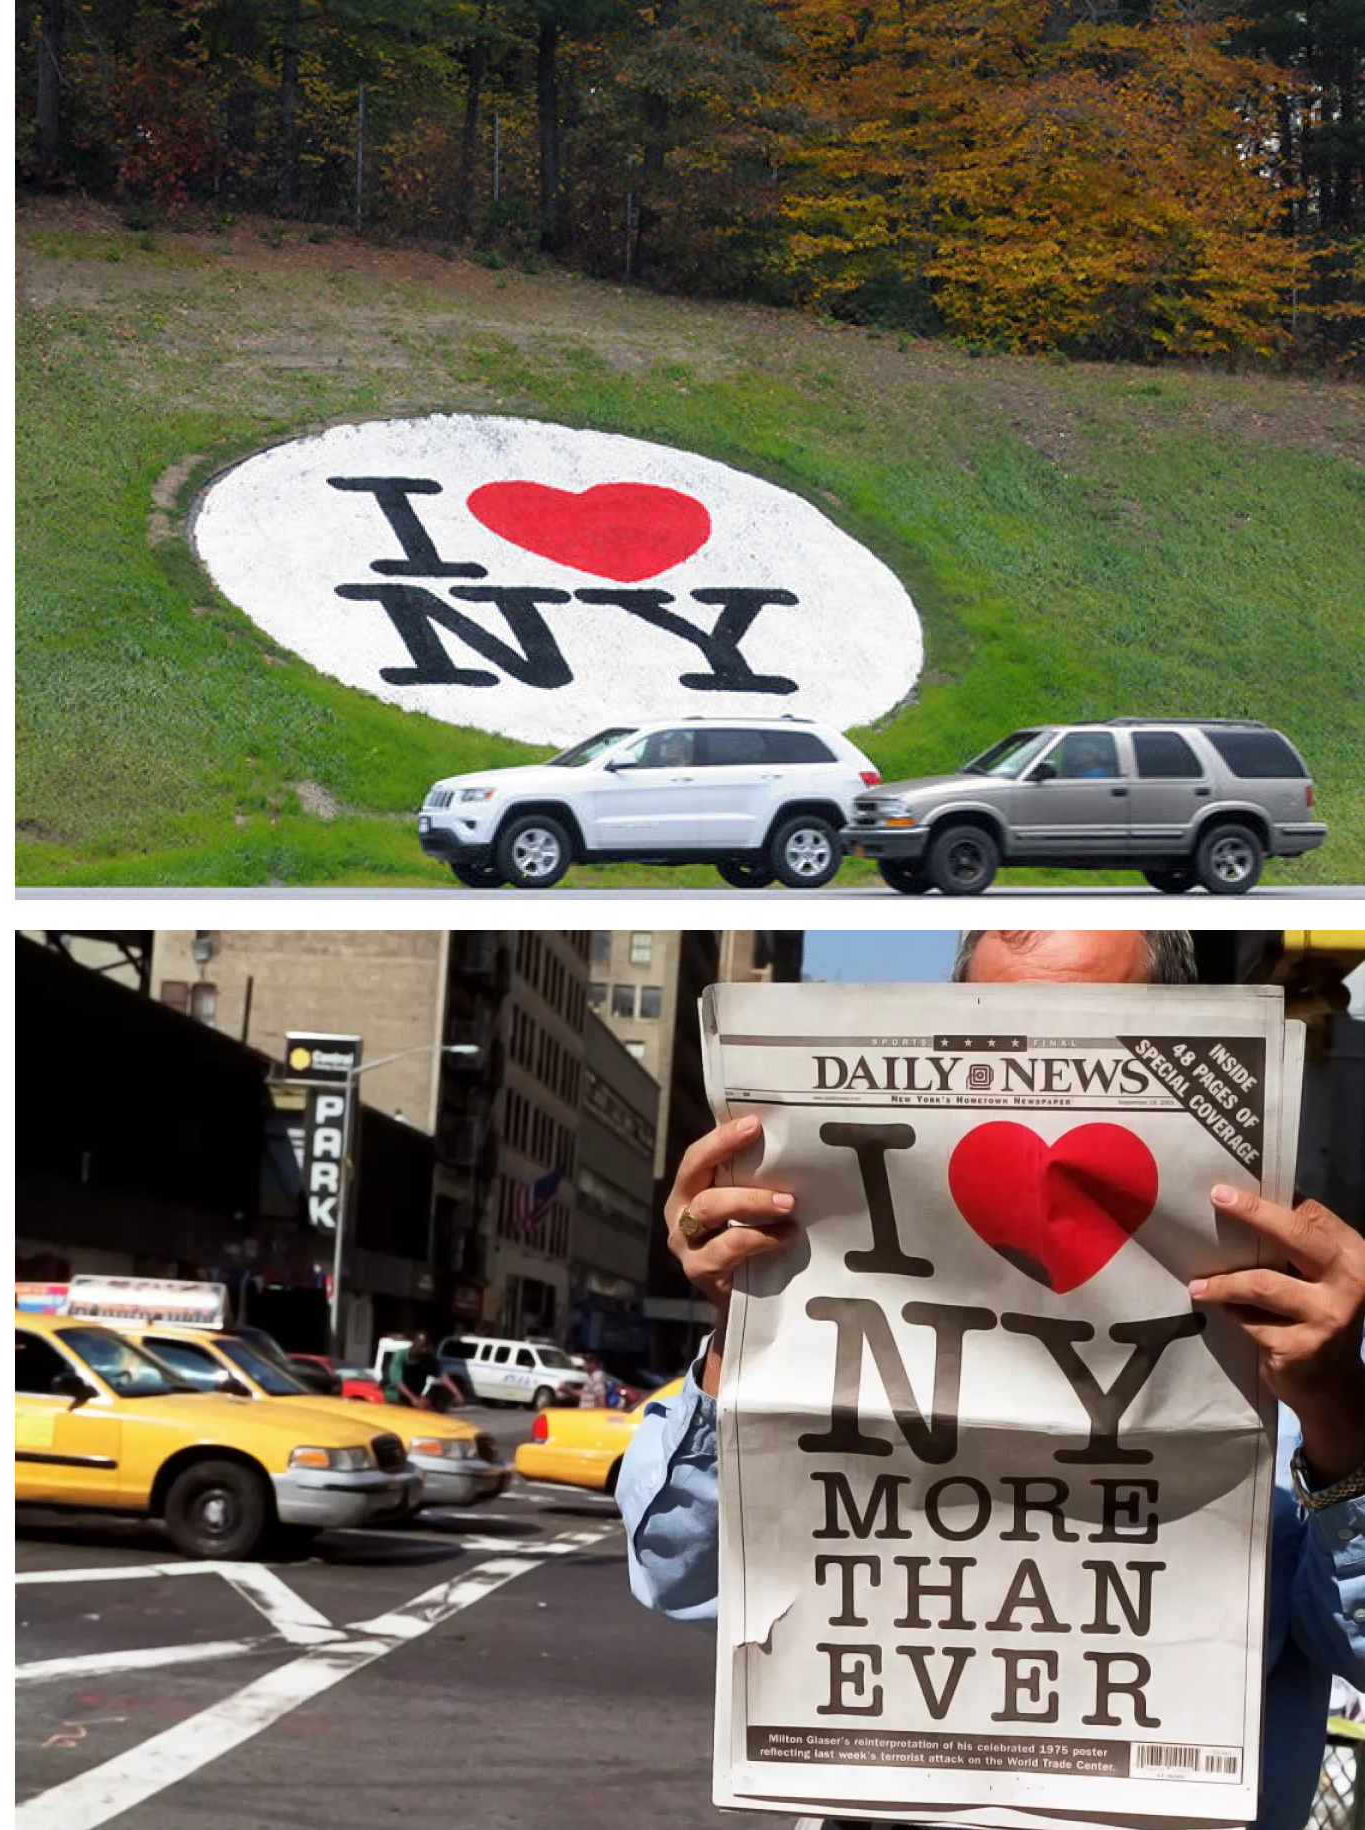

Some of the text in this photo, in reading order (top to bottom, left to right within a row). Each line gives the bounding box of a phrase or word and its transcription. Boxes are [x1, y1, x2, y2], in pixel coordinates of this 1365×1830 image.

[326, 476, 488, 579] I
[334, 583, 799, 695] NY
[812, 1054, 1150, 1095] DAILY NEWS
[872, 1038, 1077, 1047] SPORTS FINAL
[1208, 1043, 1258, 1094] INSIDE
[1135, 1039, 1260, 1166] SPECIAL COVERAGE
[1172, 1043, 1260, 1129] 48 PAGES OF
[308, 1095, 344, 1228] PARK
[819, 1121, 934, 1278] I
[798, 1296, 1207, 1466] NY
[811, 1471, 1160, 1545] MORE
[814, 1554, 1167, 1637] THAN
[815, 1642, 1162, 1729] EVER
[759, 1747, 1117, 1772] reflecting last week's terrorist attack on the World Trade Center.
[768, 1733, 1108, 1759] Milton Glaser's reinterpretation of his celebrated 1975 poster
